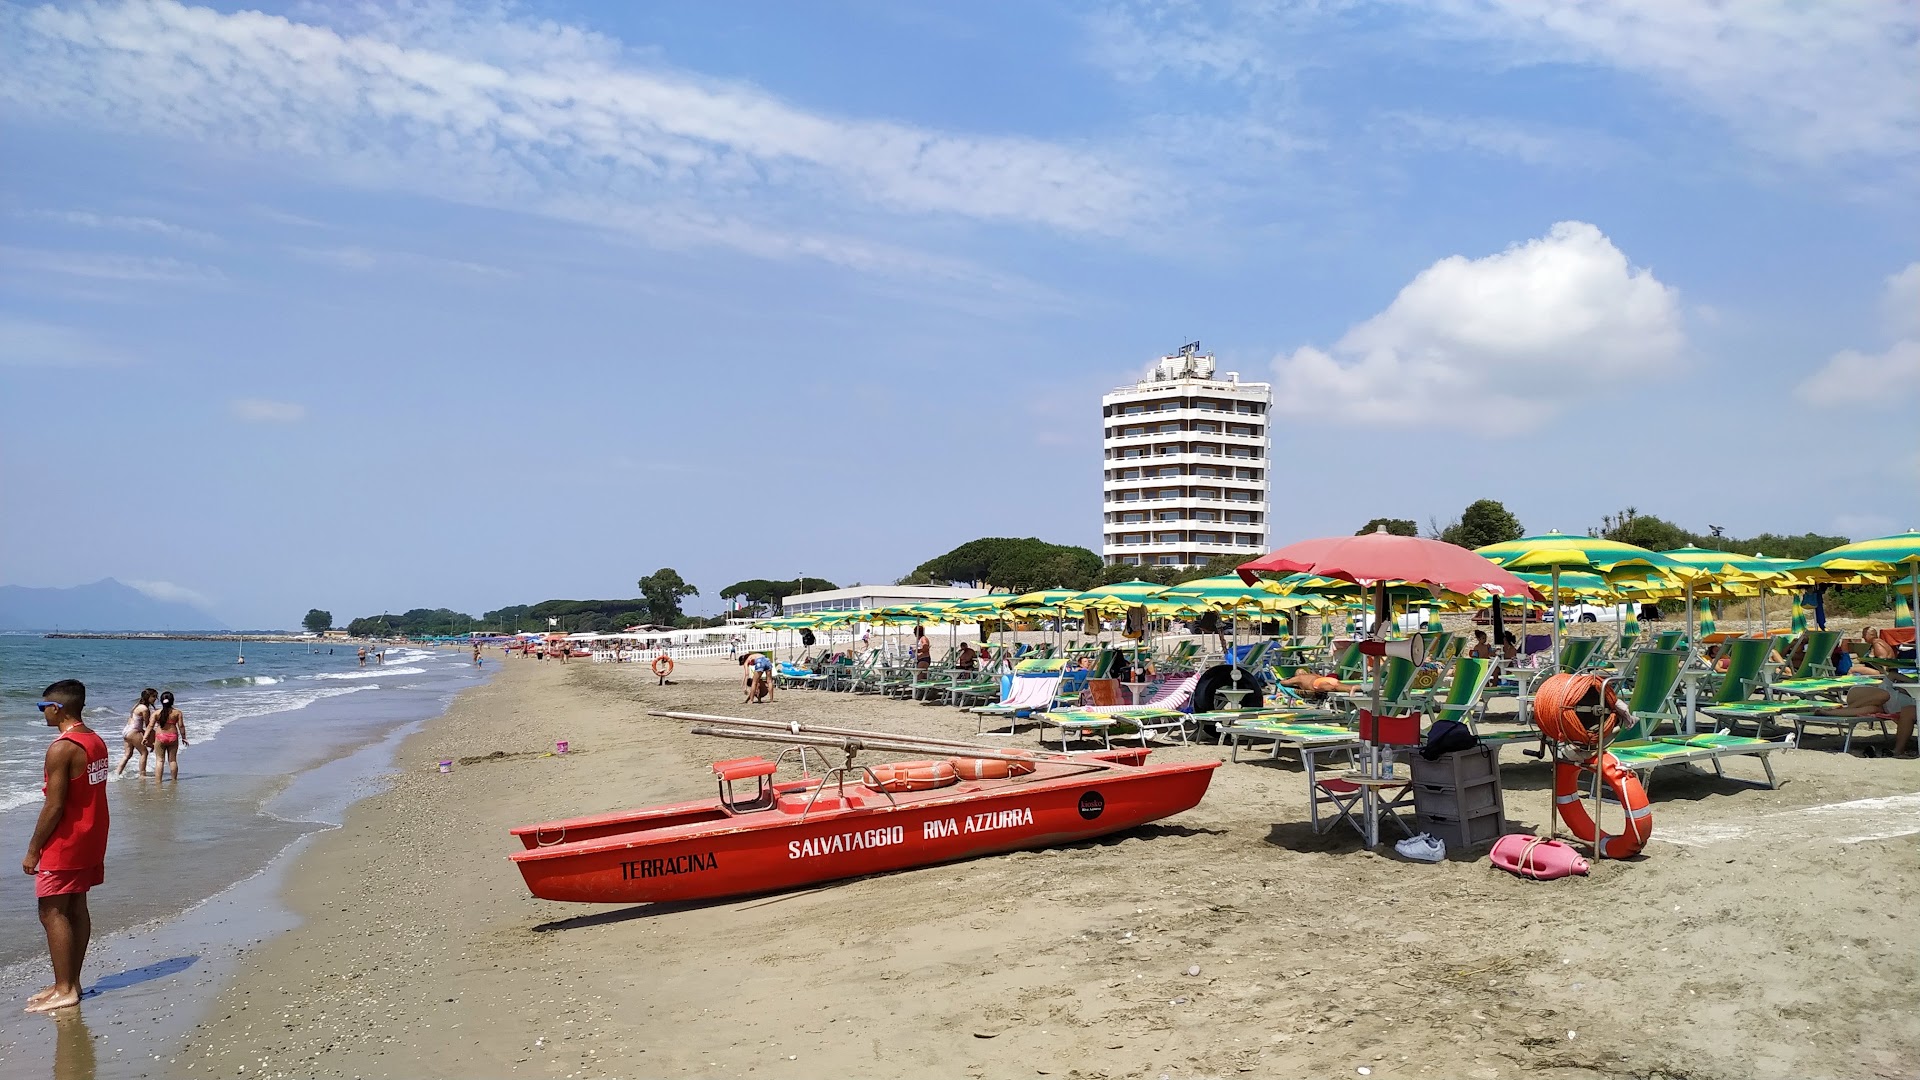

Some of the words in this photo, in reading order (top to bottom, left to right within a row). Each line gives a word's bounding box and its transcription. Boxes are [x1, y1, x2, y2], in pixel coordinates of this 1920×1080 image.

[788, 825, 904, 859] SALVATAGGIO
[923, 818, 959, 840] RIVA
[963, 807, 1034, 835] AZZURRA
[619, 851, 719, 881] TERRACINA
